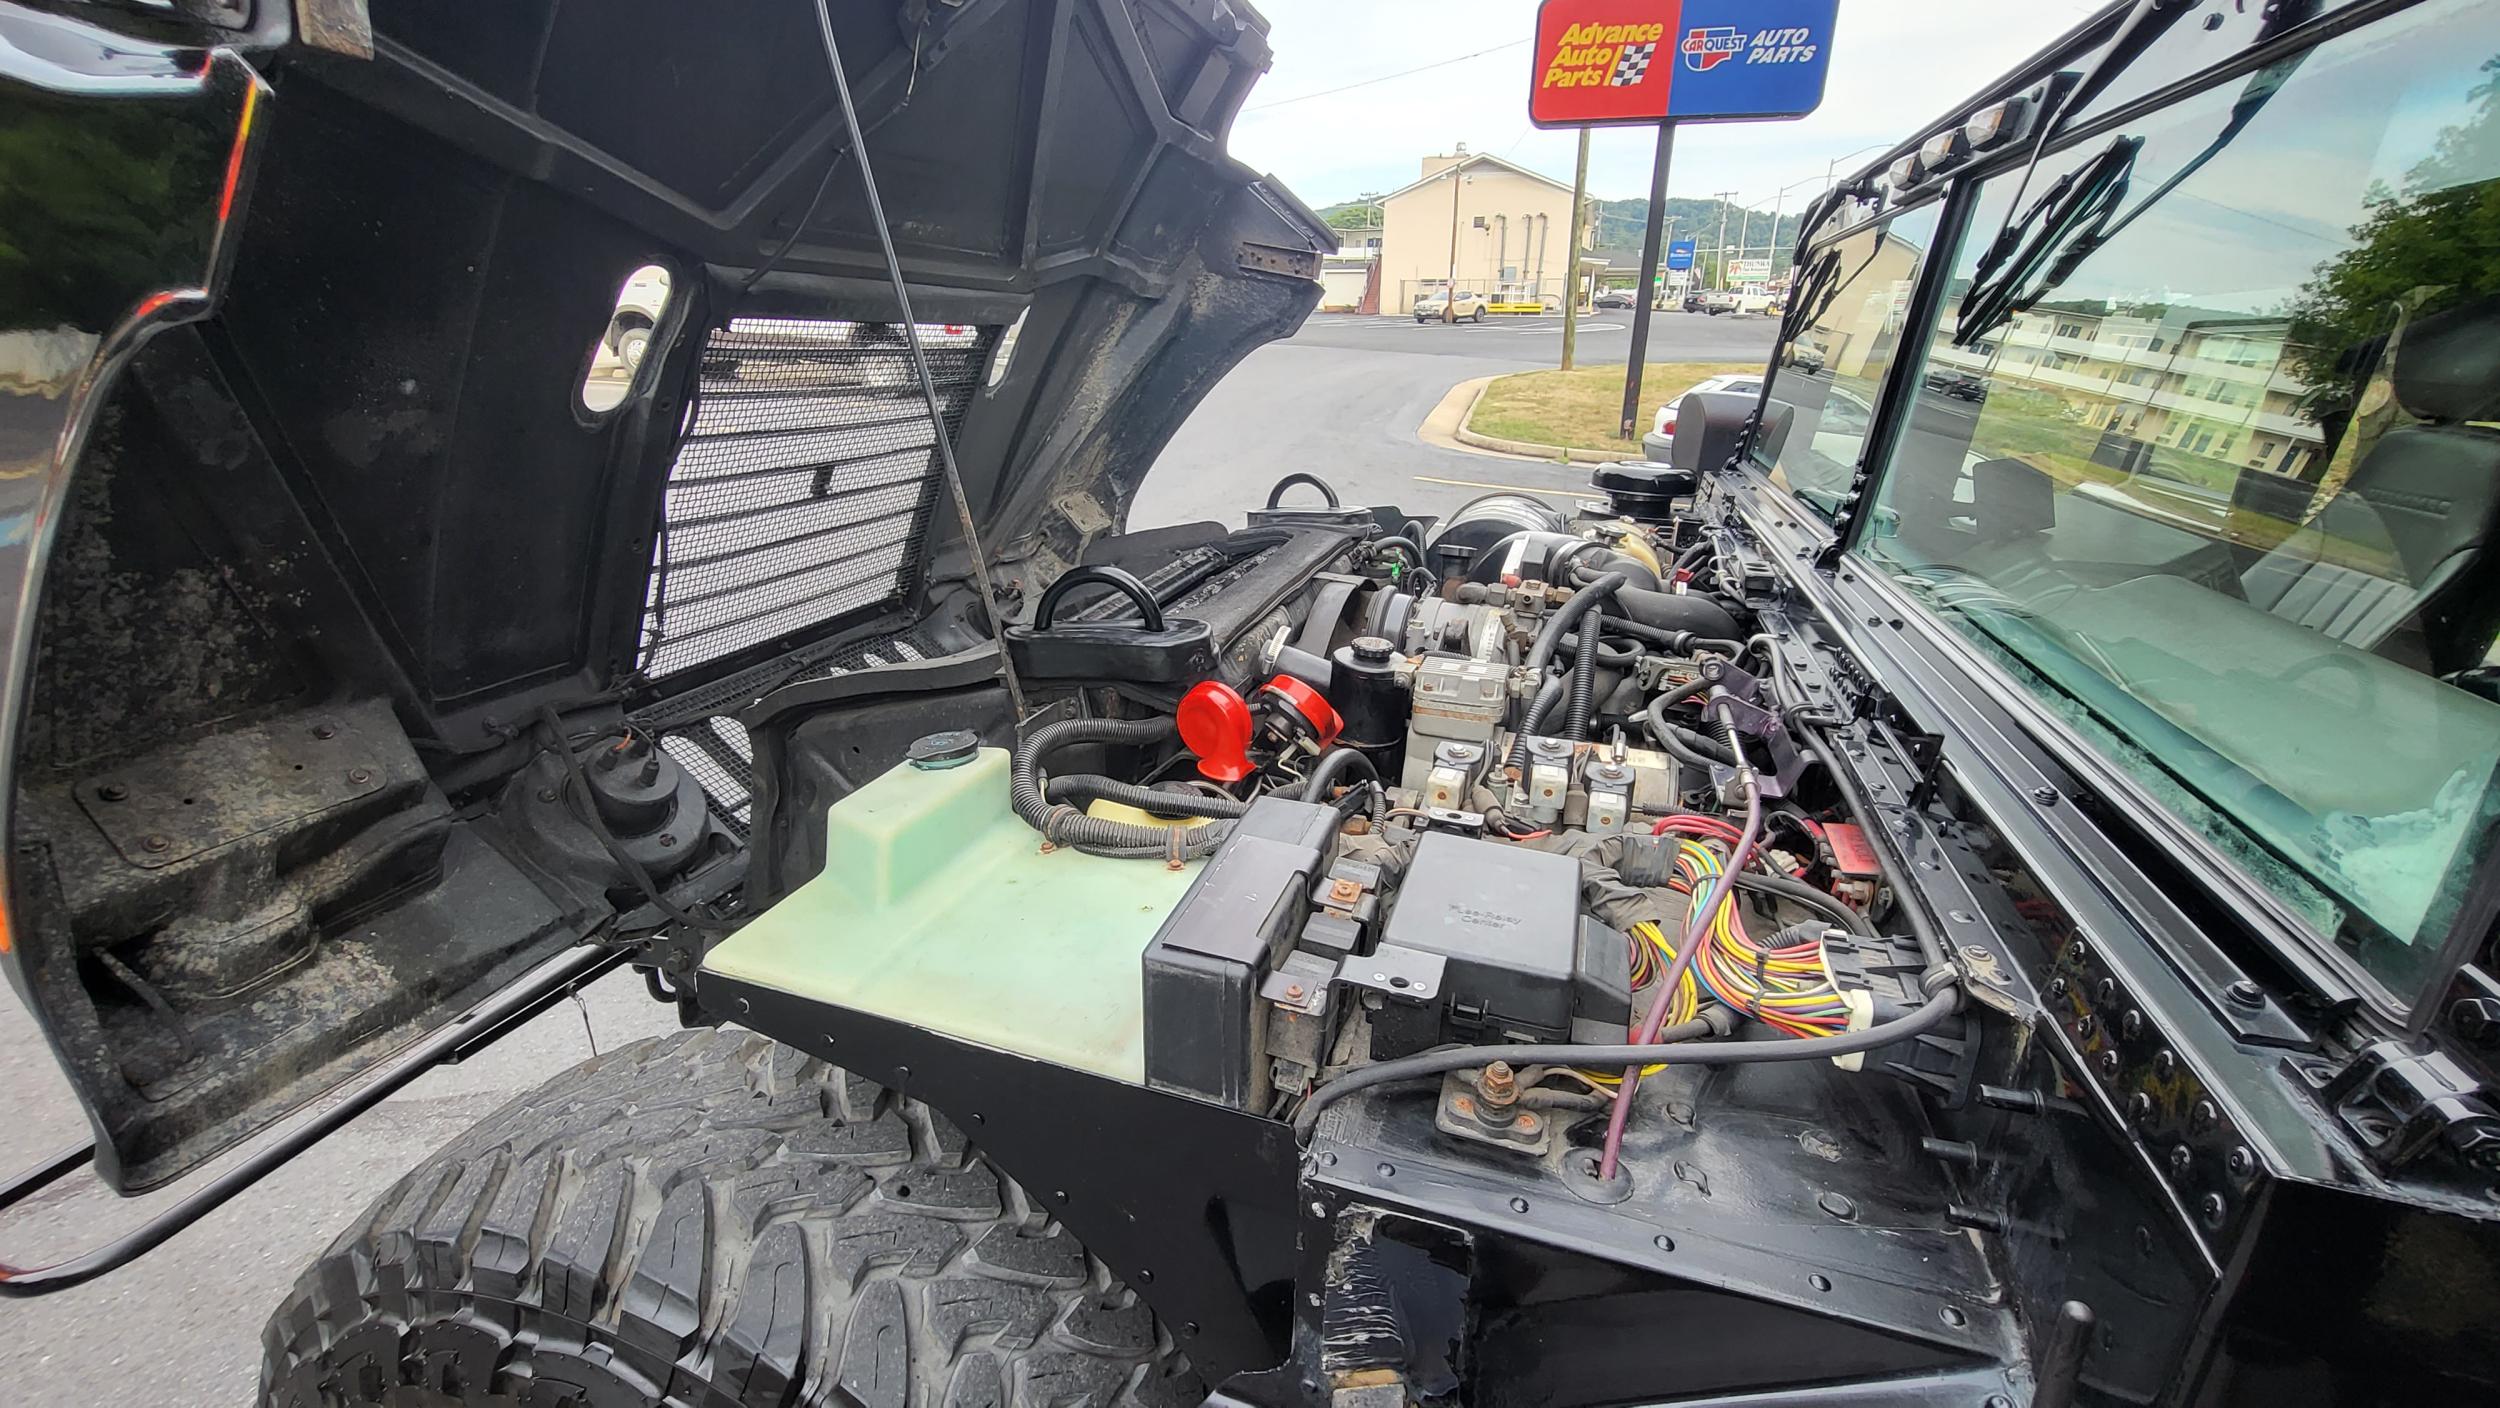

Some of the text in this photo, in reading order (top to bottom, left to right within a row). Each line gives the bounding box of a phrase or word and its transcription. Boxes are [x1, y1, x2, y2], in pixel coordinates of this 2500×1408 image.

[1557, 22, 1664, 46] Advance
[1749, 28, 1809, 47] AUTO
[1683, 37, 1745, 52] CARQUEST
[1550, 46, 1613, 67] Auto
[1746, 45, 1817, 65] PARTS
[1542, 67, 1602, 88] Parts
